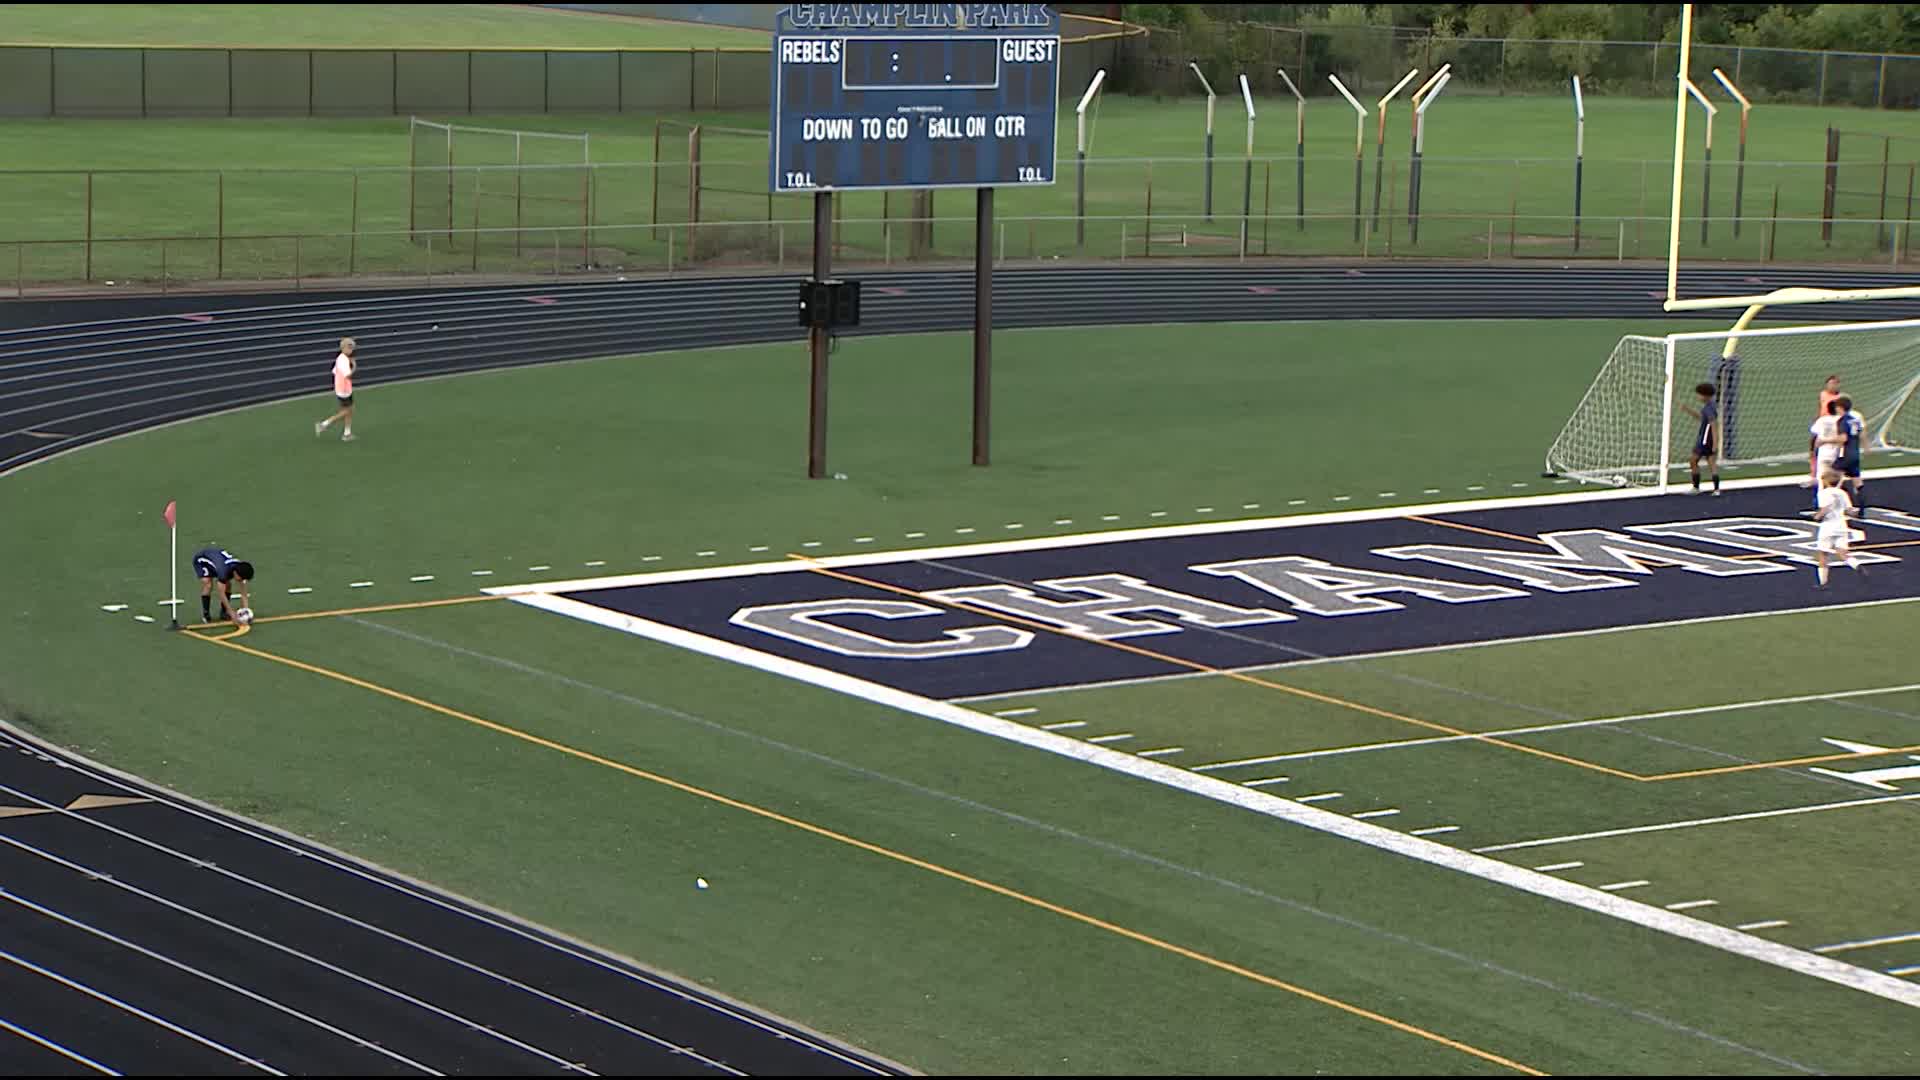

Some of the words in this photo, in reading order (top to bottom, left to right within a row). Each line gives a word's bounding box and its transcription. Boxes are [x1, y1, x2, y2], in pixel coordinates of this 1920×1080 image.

[790, 4, 960, 27] CHAMPLIN
[964, 4, 1050, 27] PARK
[783, 40, 840, 63] REBELS
[1002, 40, 1056, 62] GUEST
[803, 118, 853, 141] DOWN
[861, 118, 881, 140] TO
[886, 117, 908, 140] GO
[928, 117, 963, 139] BALL
[966, 116, 986, 138] ON
[995, 115, 1026, 138] QTR
[729, 507, 1920, 660] CHAMP
